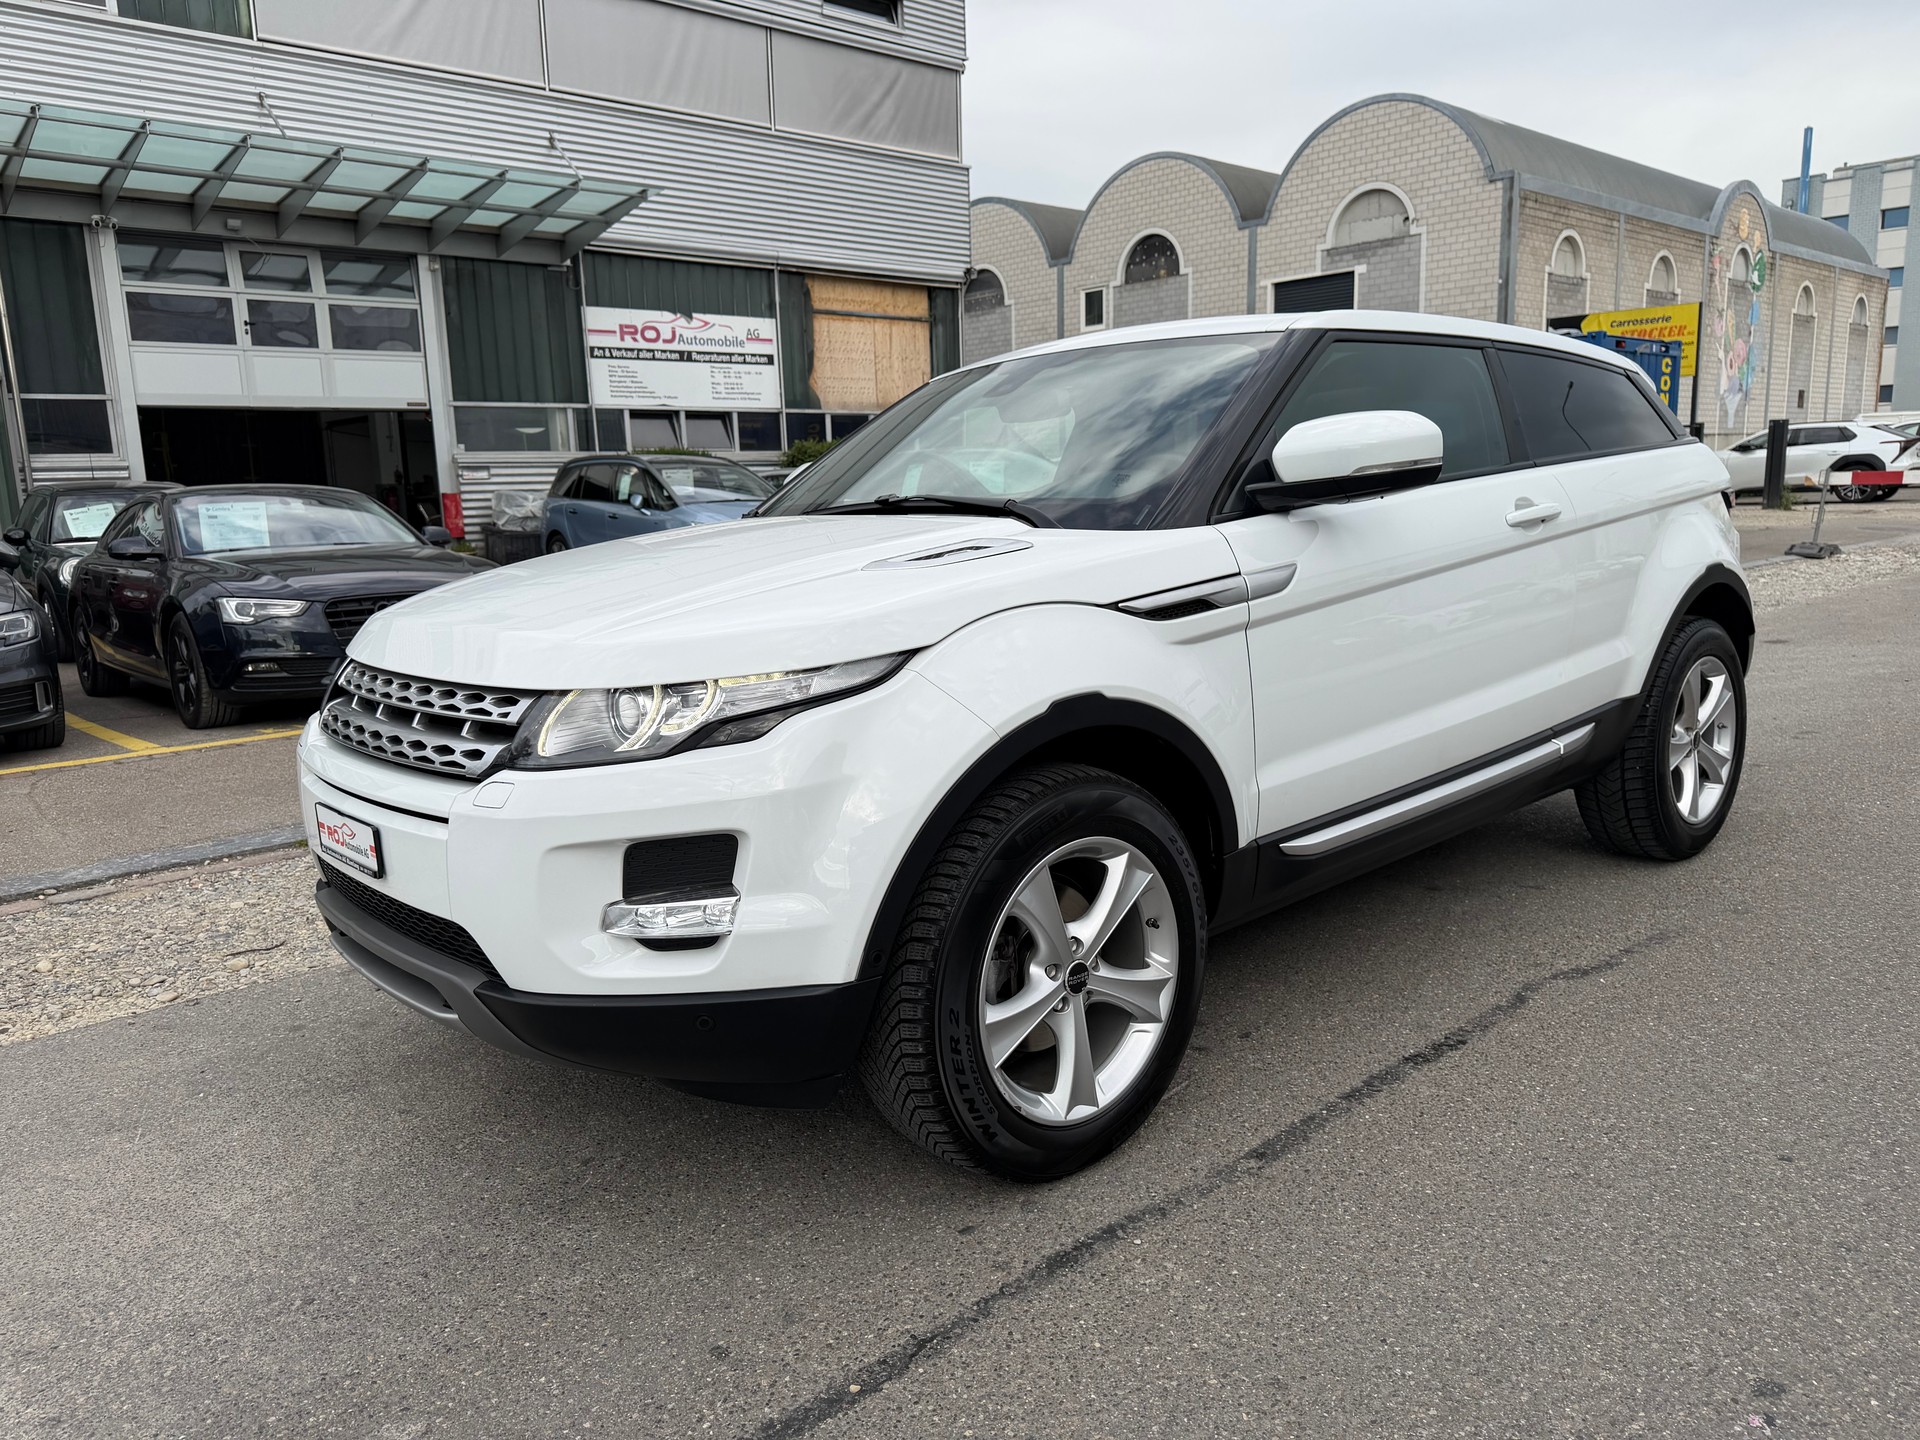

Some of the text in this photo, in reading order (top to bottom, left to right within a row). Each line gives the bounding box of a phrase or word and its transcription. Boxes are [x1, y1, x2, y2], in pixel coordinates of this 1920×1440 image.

[618, 324, 760, 348] ROJ Automobile AG
[593, 347, 604, 357] An
[605, 348, 611, 358] &
[611, 348, 638, 359] Verkauf
[638, 349, 653, 359] aller
[654, 350, 680, 360] Marken
[691, 352, 730, 363] Reparaturen
[731, 354, 744, 363] aller
[745, 354, 769, 364] Marken
[326, 824, 345, 847] ROJ
[1068, 971, 1089, 986] RANGE ROVER
[949, 1007, 999, 1142] WINTER 2
